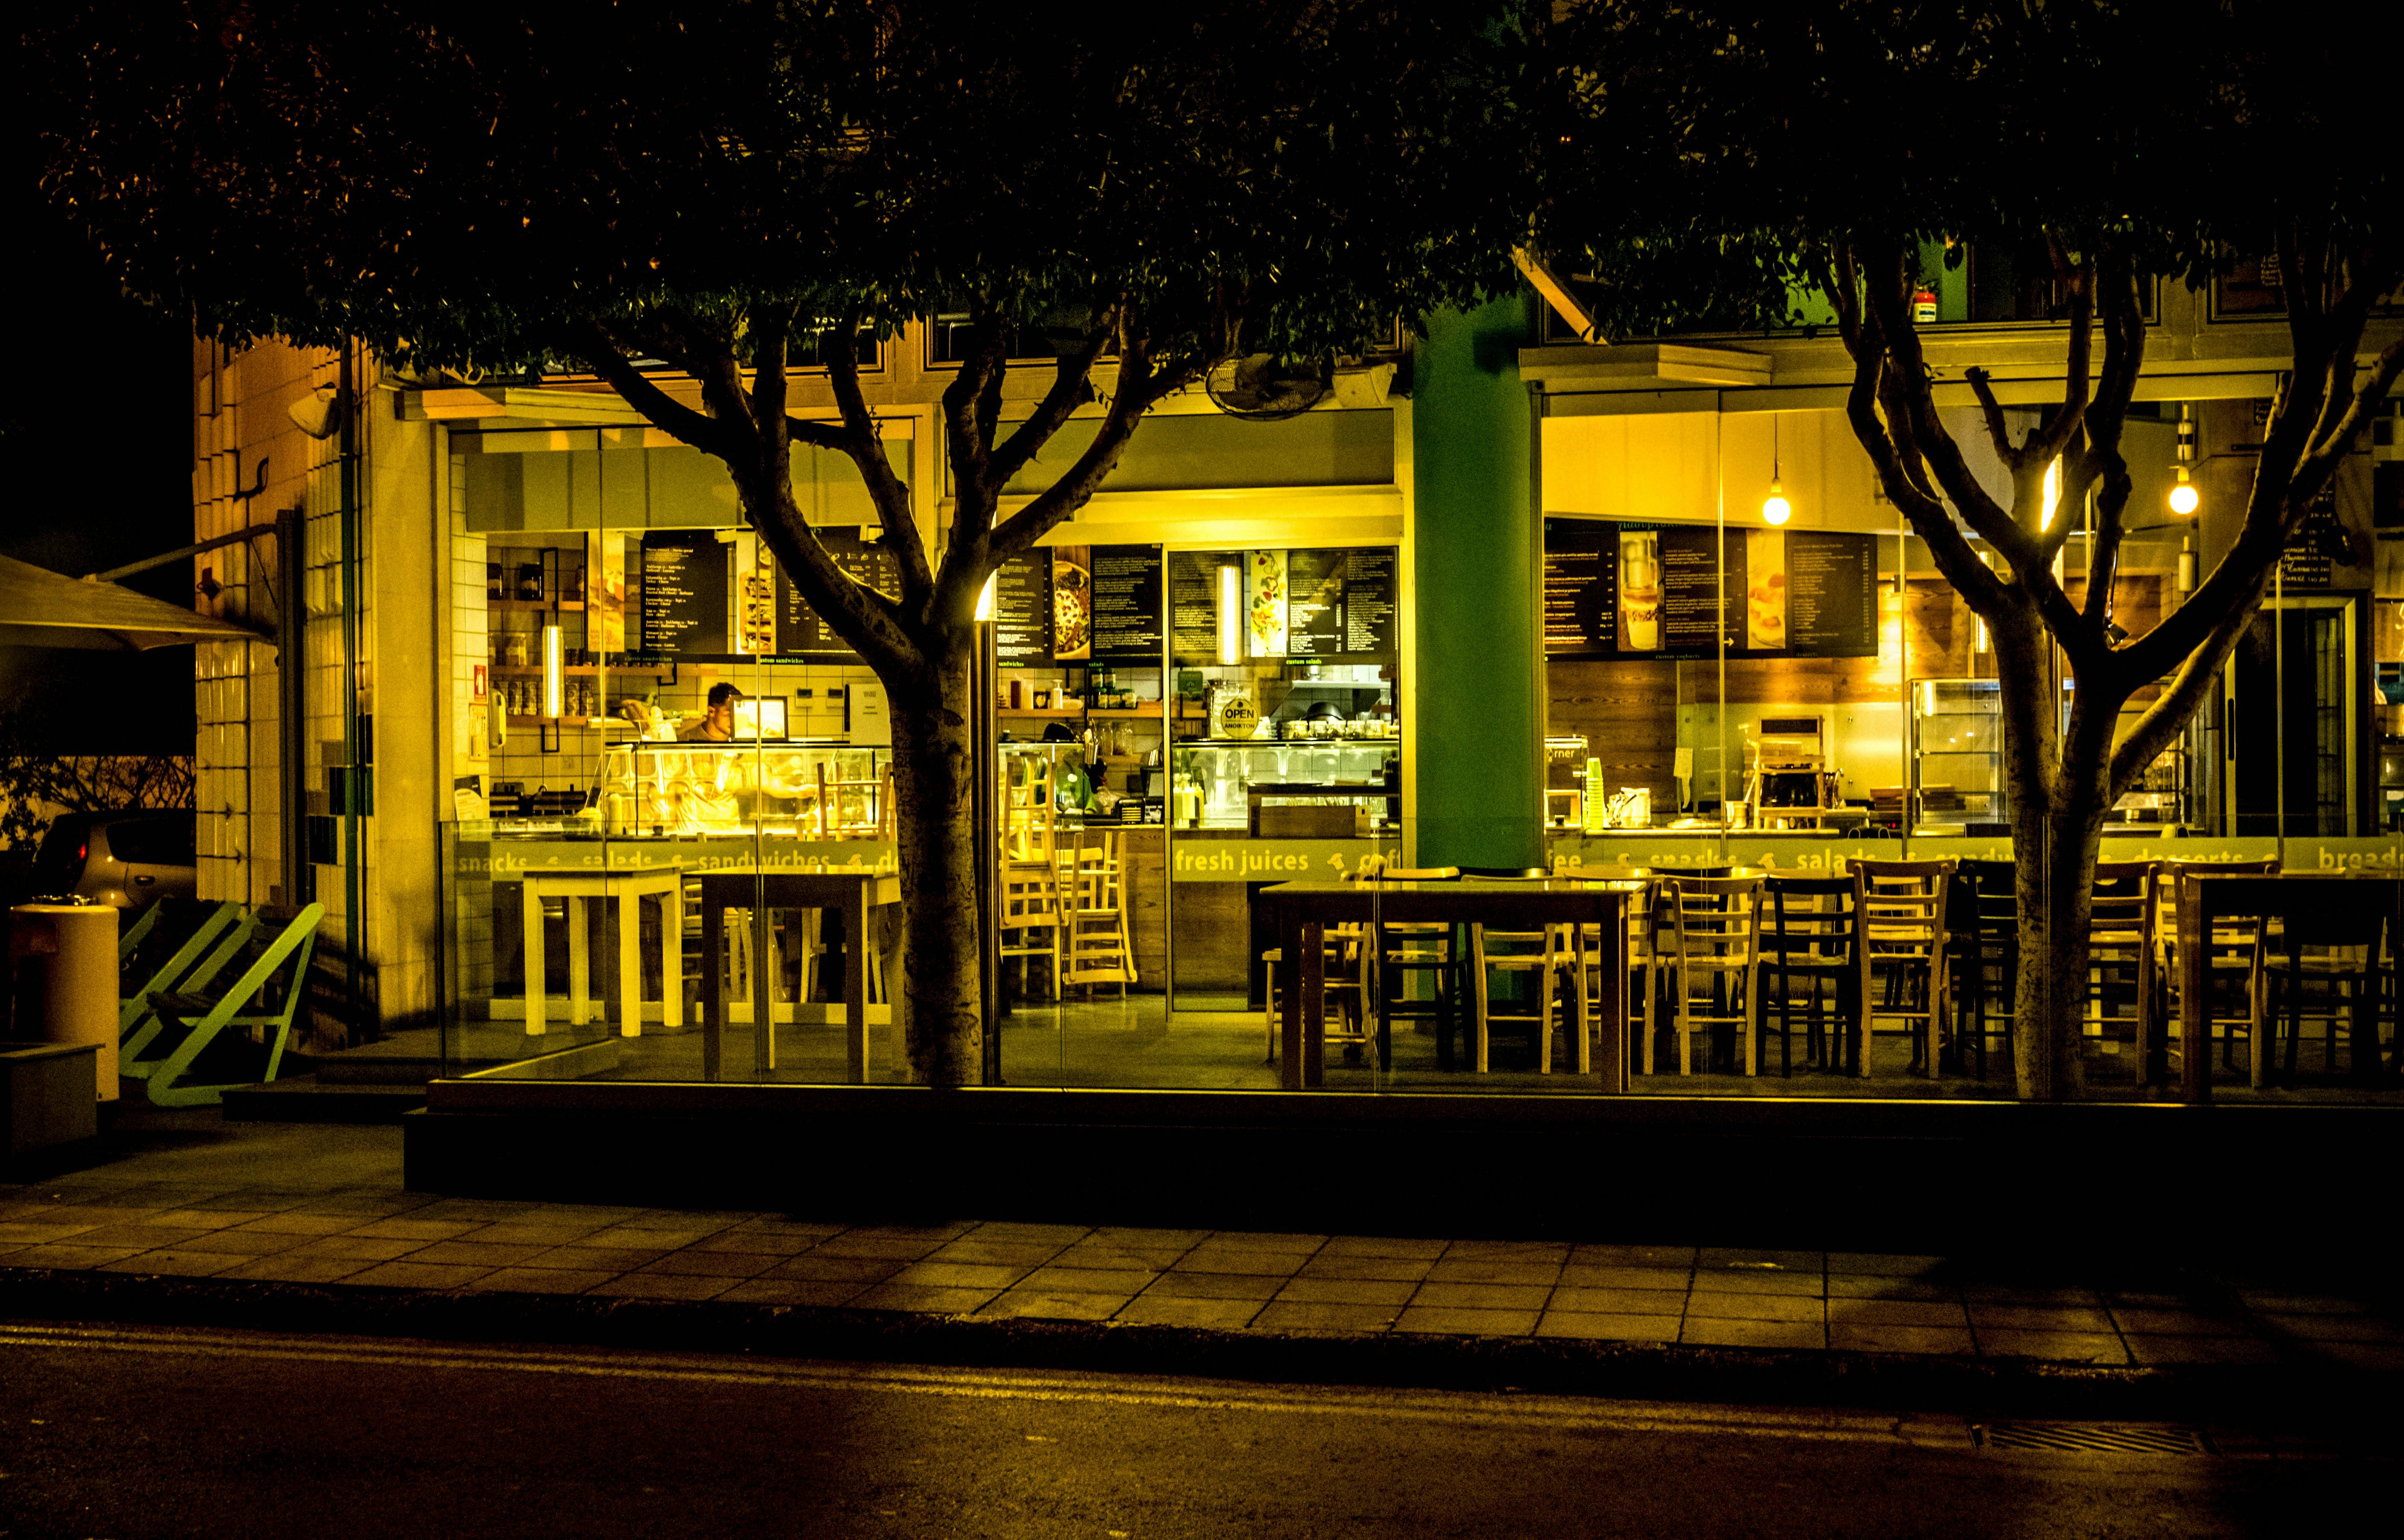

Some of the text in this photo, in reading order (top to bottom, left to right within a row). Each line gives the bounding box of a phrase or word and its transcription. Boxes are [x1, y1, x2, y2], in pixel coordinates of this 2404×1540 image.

[1225, 709, 1254, 719] OPEN
[458, 851, 526, 872] snacks
[698, 850, 829, 870] sandwiches
[1176, 849, 1309, 876] fresh juices
[2319, 846, 2404, 870] bread
